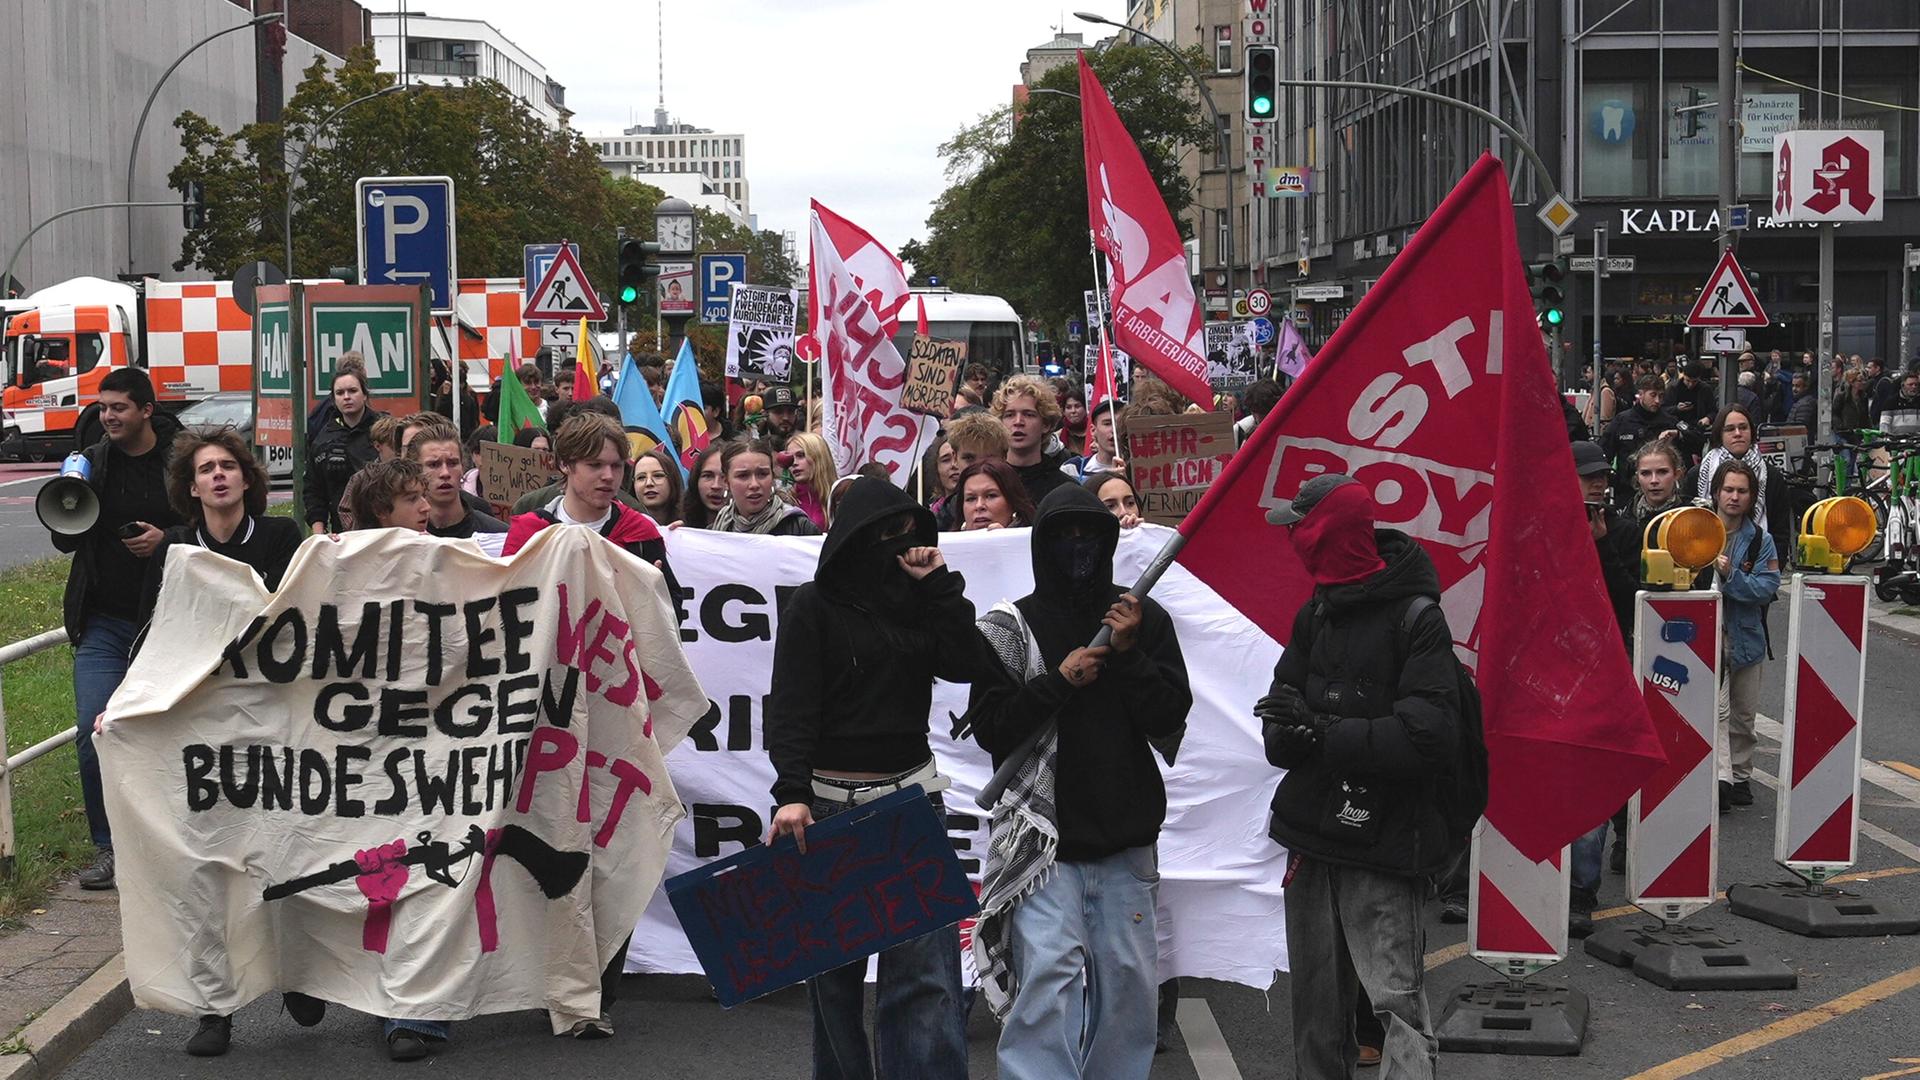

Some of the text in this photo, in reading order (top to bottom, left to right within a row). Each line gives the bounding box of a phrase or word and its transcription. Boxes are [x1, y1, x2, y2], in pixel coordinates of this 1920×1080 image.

[1748, 111, 1793, 121] für Kinder
[1279, 173, 1300, 185] dm
[384, 195, 429, 264] P
[1620, 208, 1722, 234] KAPLA
[709, 261, 734, 292] P
[1252, 296, 1266, 309] 30
[321, 322, 405, 379] HAN
[912, 340, 960, 366] SOLDATEN
[915, 363, 946, 385] SIND
[903, 384, 949, 408] MÖRDER
[487, 448, 514, 470] They
[521, 453, 537, 471] got
[489, 467, 541, 490] for WARS
[489, 486, 509, 501] can't
[212, 587, 538, 686] KOMITEE
[1652, 672, 1680, 692] USA
[314, 667, 579, 738] GEGEN
[831, 858, 967, 956] EIER
